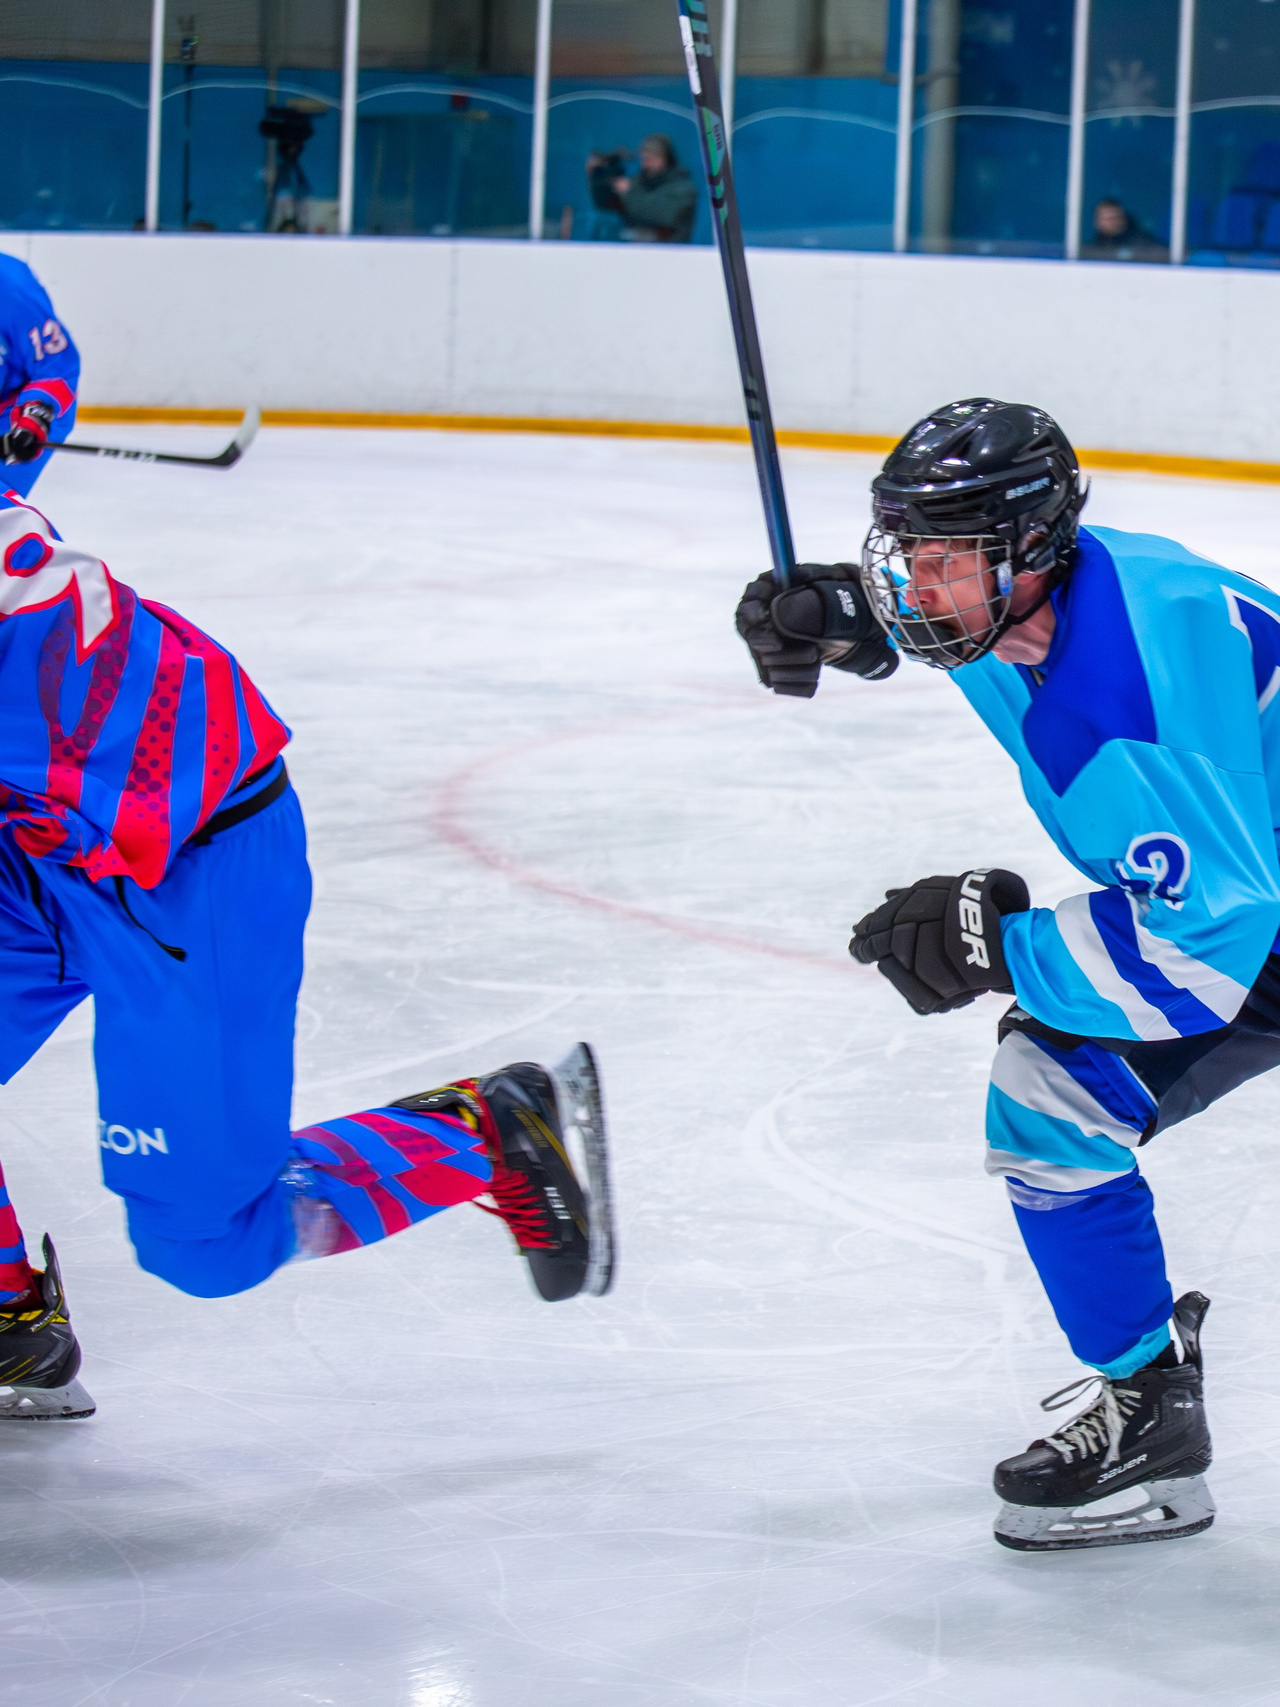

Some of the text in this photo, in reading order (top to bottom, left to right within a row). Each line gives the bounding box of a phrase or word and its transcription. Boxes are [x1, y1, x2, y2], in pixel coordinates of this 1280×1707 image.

[29, 319, 68, 361] 13
[1115, 831, 1190, 912] 2
[958, 867, 991, 969] UER
